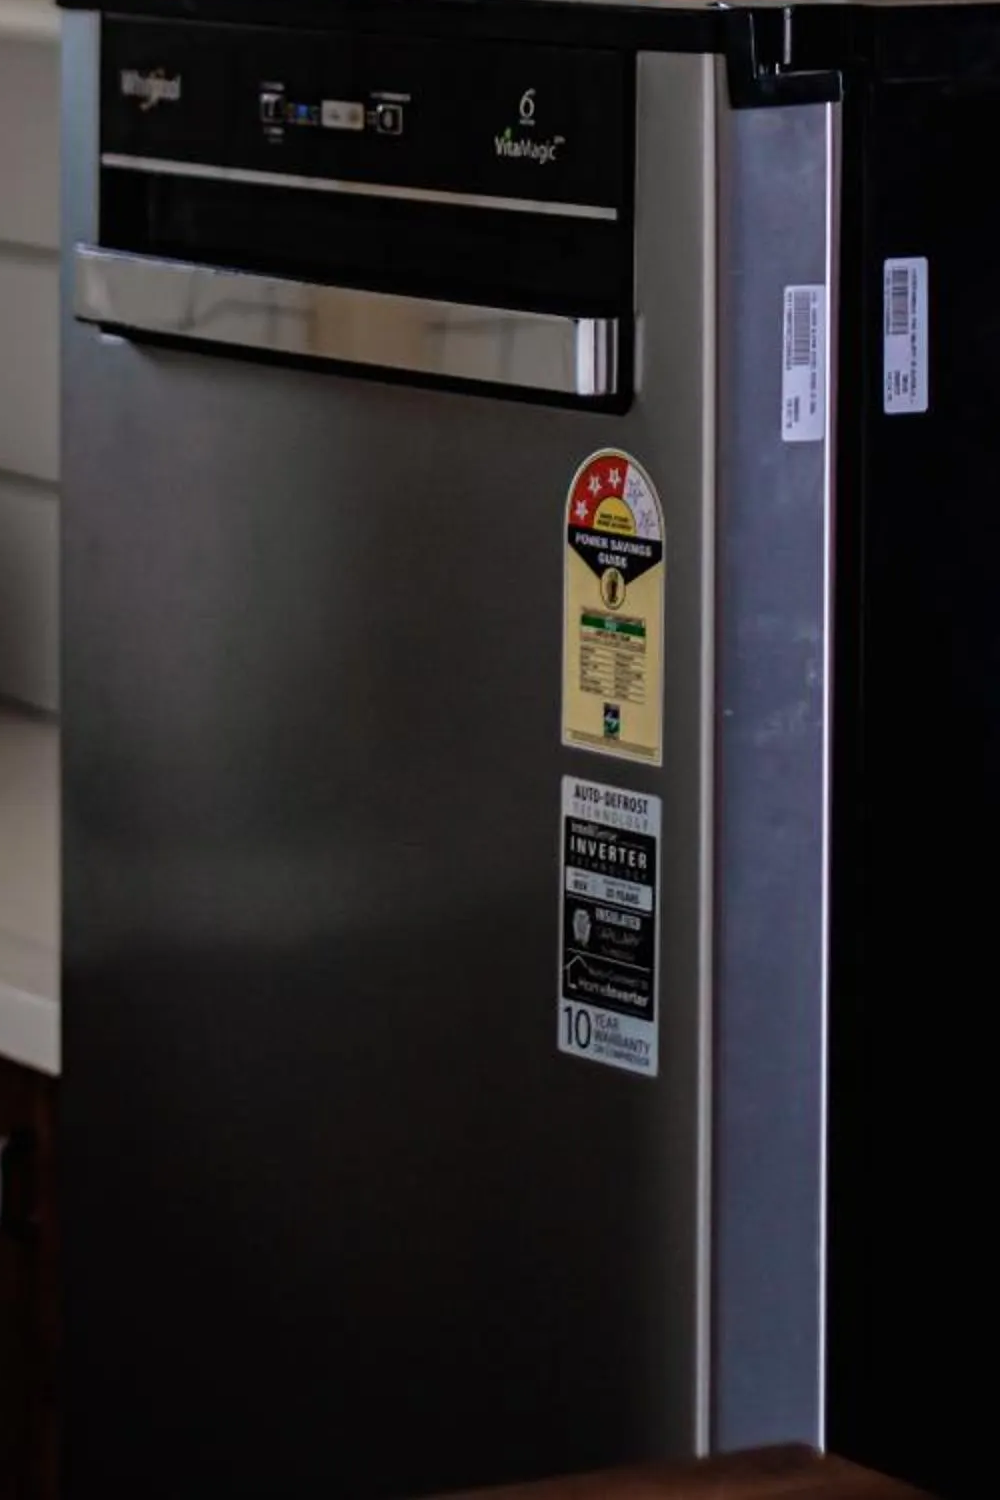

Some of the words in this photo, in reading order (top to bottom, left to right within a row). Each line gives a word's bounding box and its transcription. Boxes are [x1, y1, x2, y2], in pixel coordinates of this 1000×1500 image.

[519, 88, 536, 117] 6
[575, 532, 608, 549] POWER
[610, 539, 652, 557] SAVINGS
[574, 784, 648, 815] AUTO-DEFROST
[570, 835, 647, 869] INVERTER
[563, 1006, 591, 1049] 10
